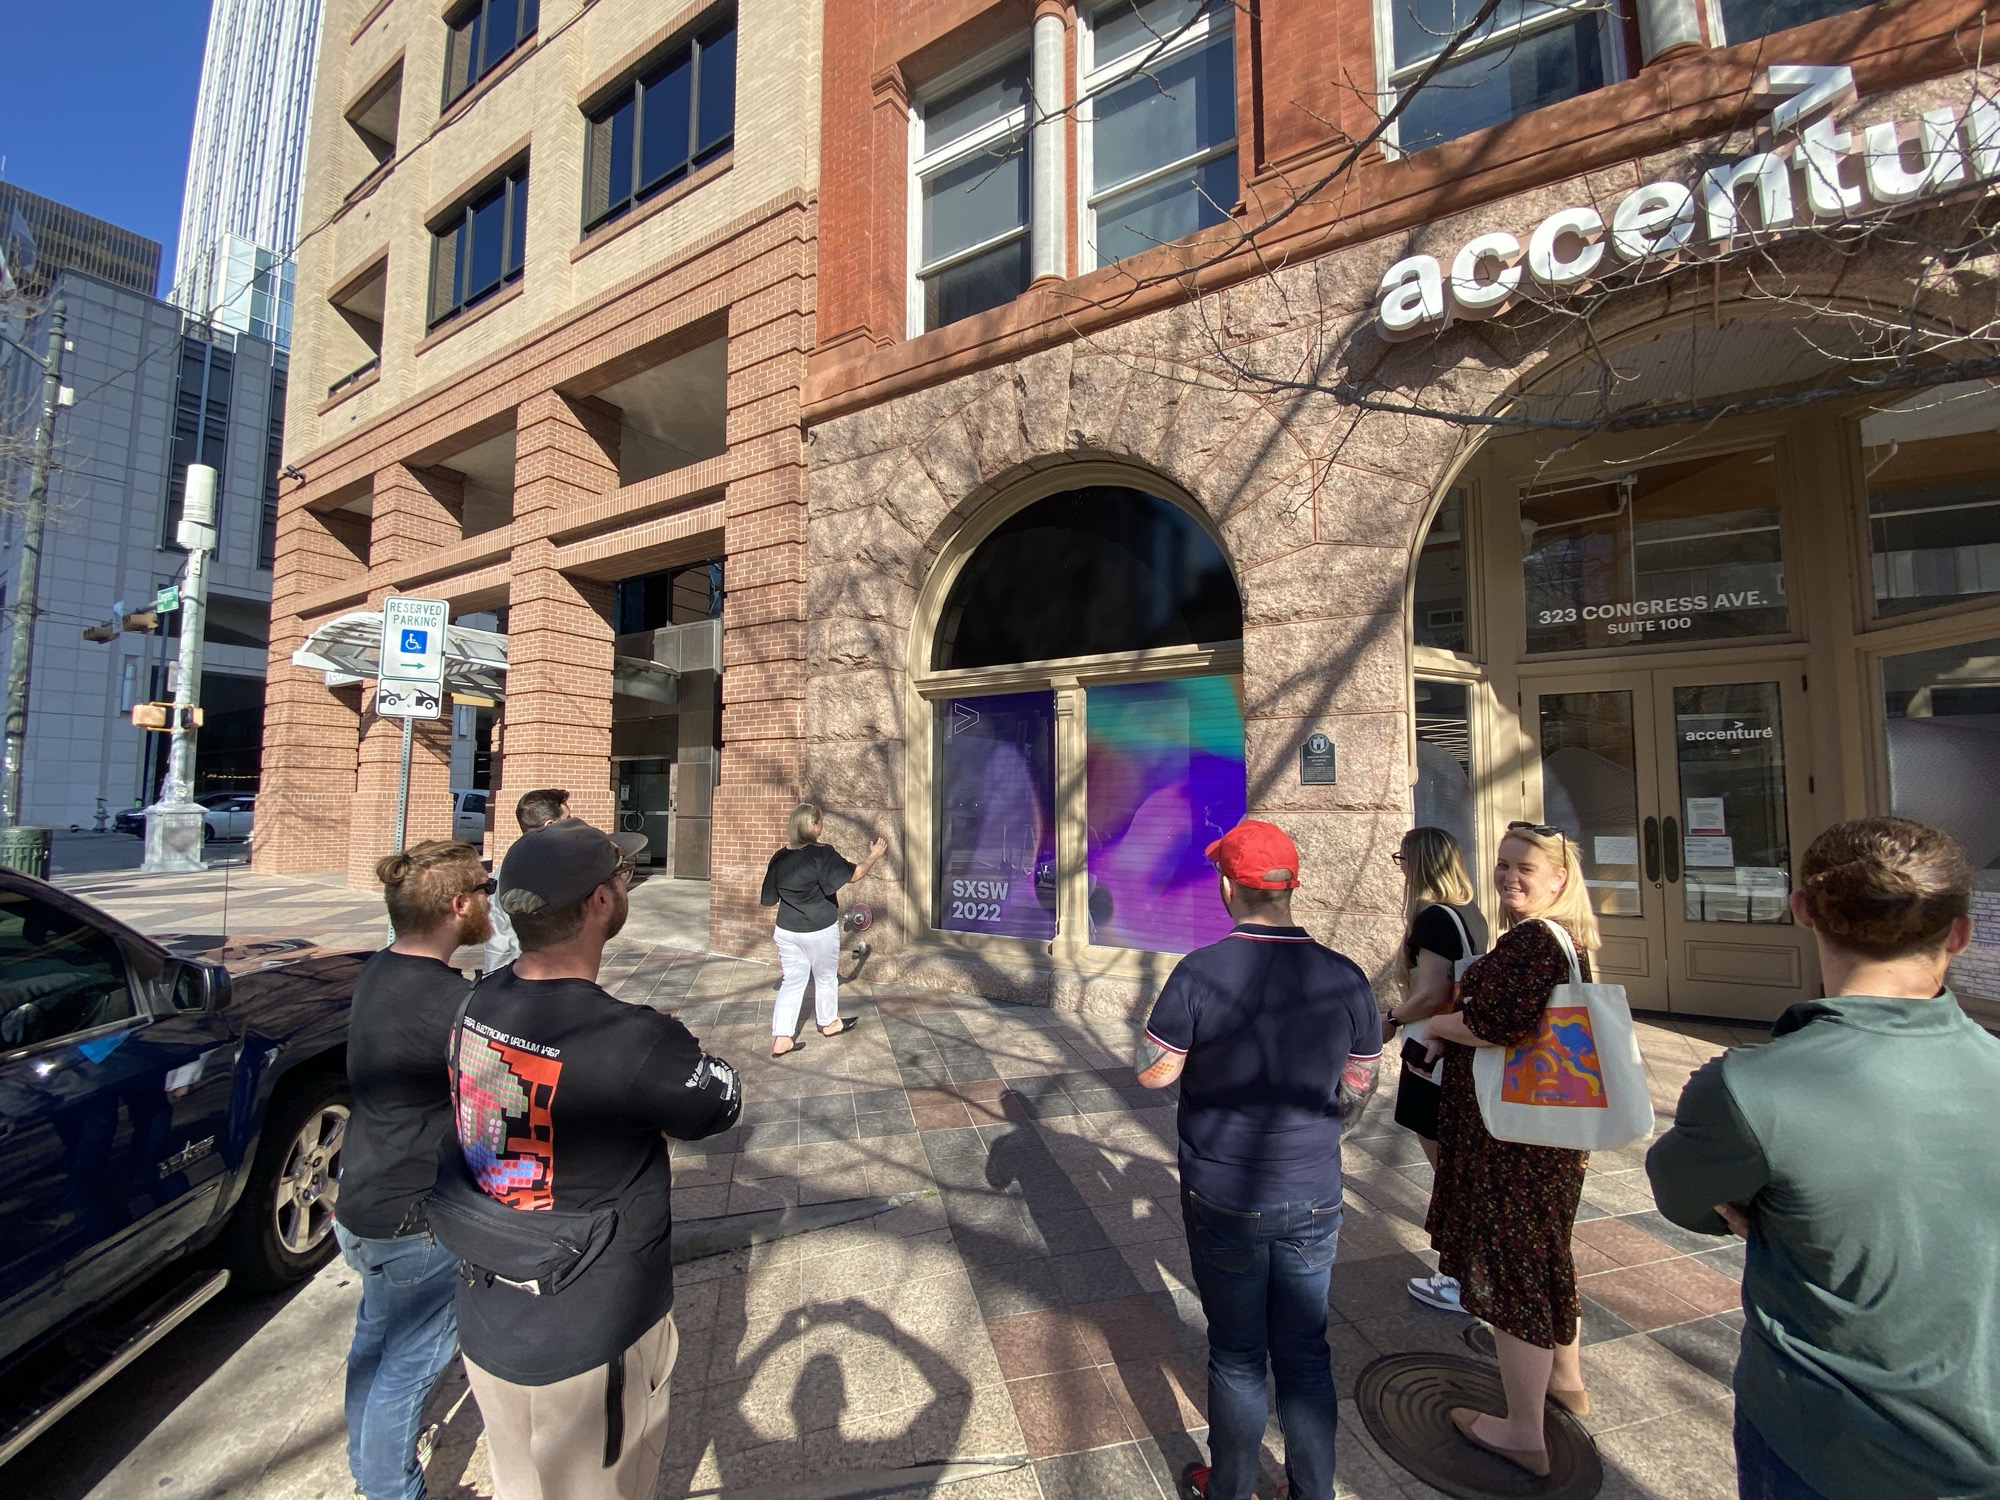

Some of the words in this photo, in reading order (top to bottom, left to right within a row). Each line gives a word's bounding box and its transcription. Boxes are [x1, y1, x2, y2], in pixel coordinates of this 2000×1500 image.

[390, 602, 441, 615] RESERVED
[1539, 608, 1577, 624] 323
[1582, 595, 1708, 619] CONGRESS
[1714, 590, 1768, 609] AVE.
[393, 615, 437, 627] PARKING
[1607, 620, 1655, 634] SUITE
[1661, 617, 1692, 630] 100
[1685, 727, 1773, 741] accenture
[952, 879, 1009, 900] SXSW
[952, 901, 1001, 921] 2022
[476, 1022, 510, 1043] ELECTRONIC
[510, 1036, 540, 1053] VACUUM
